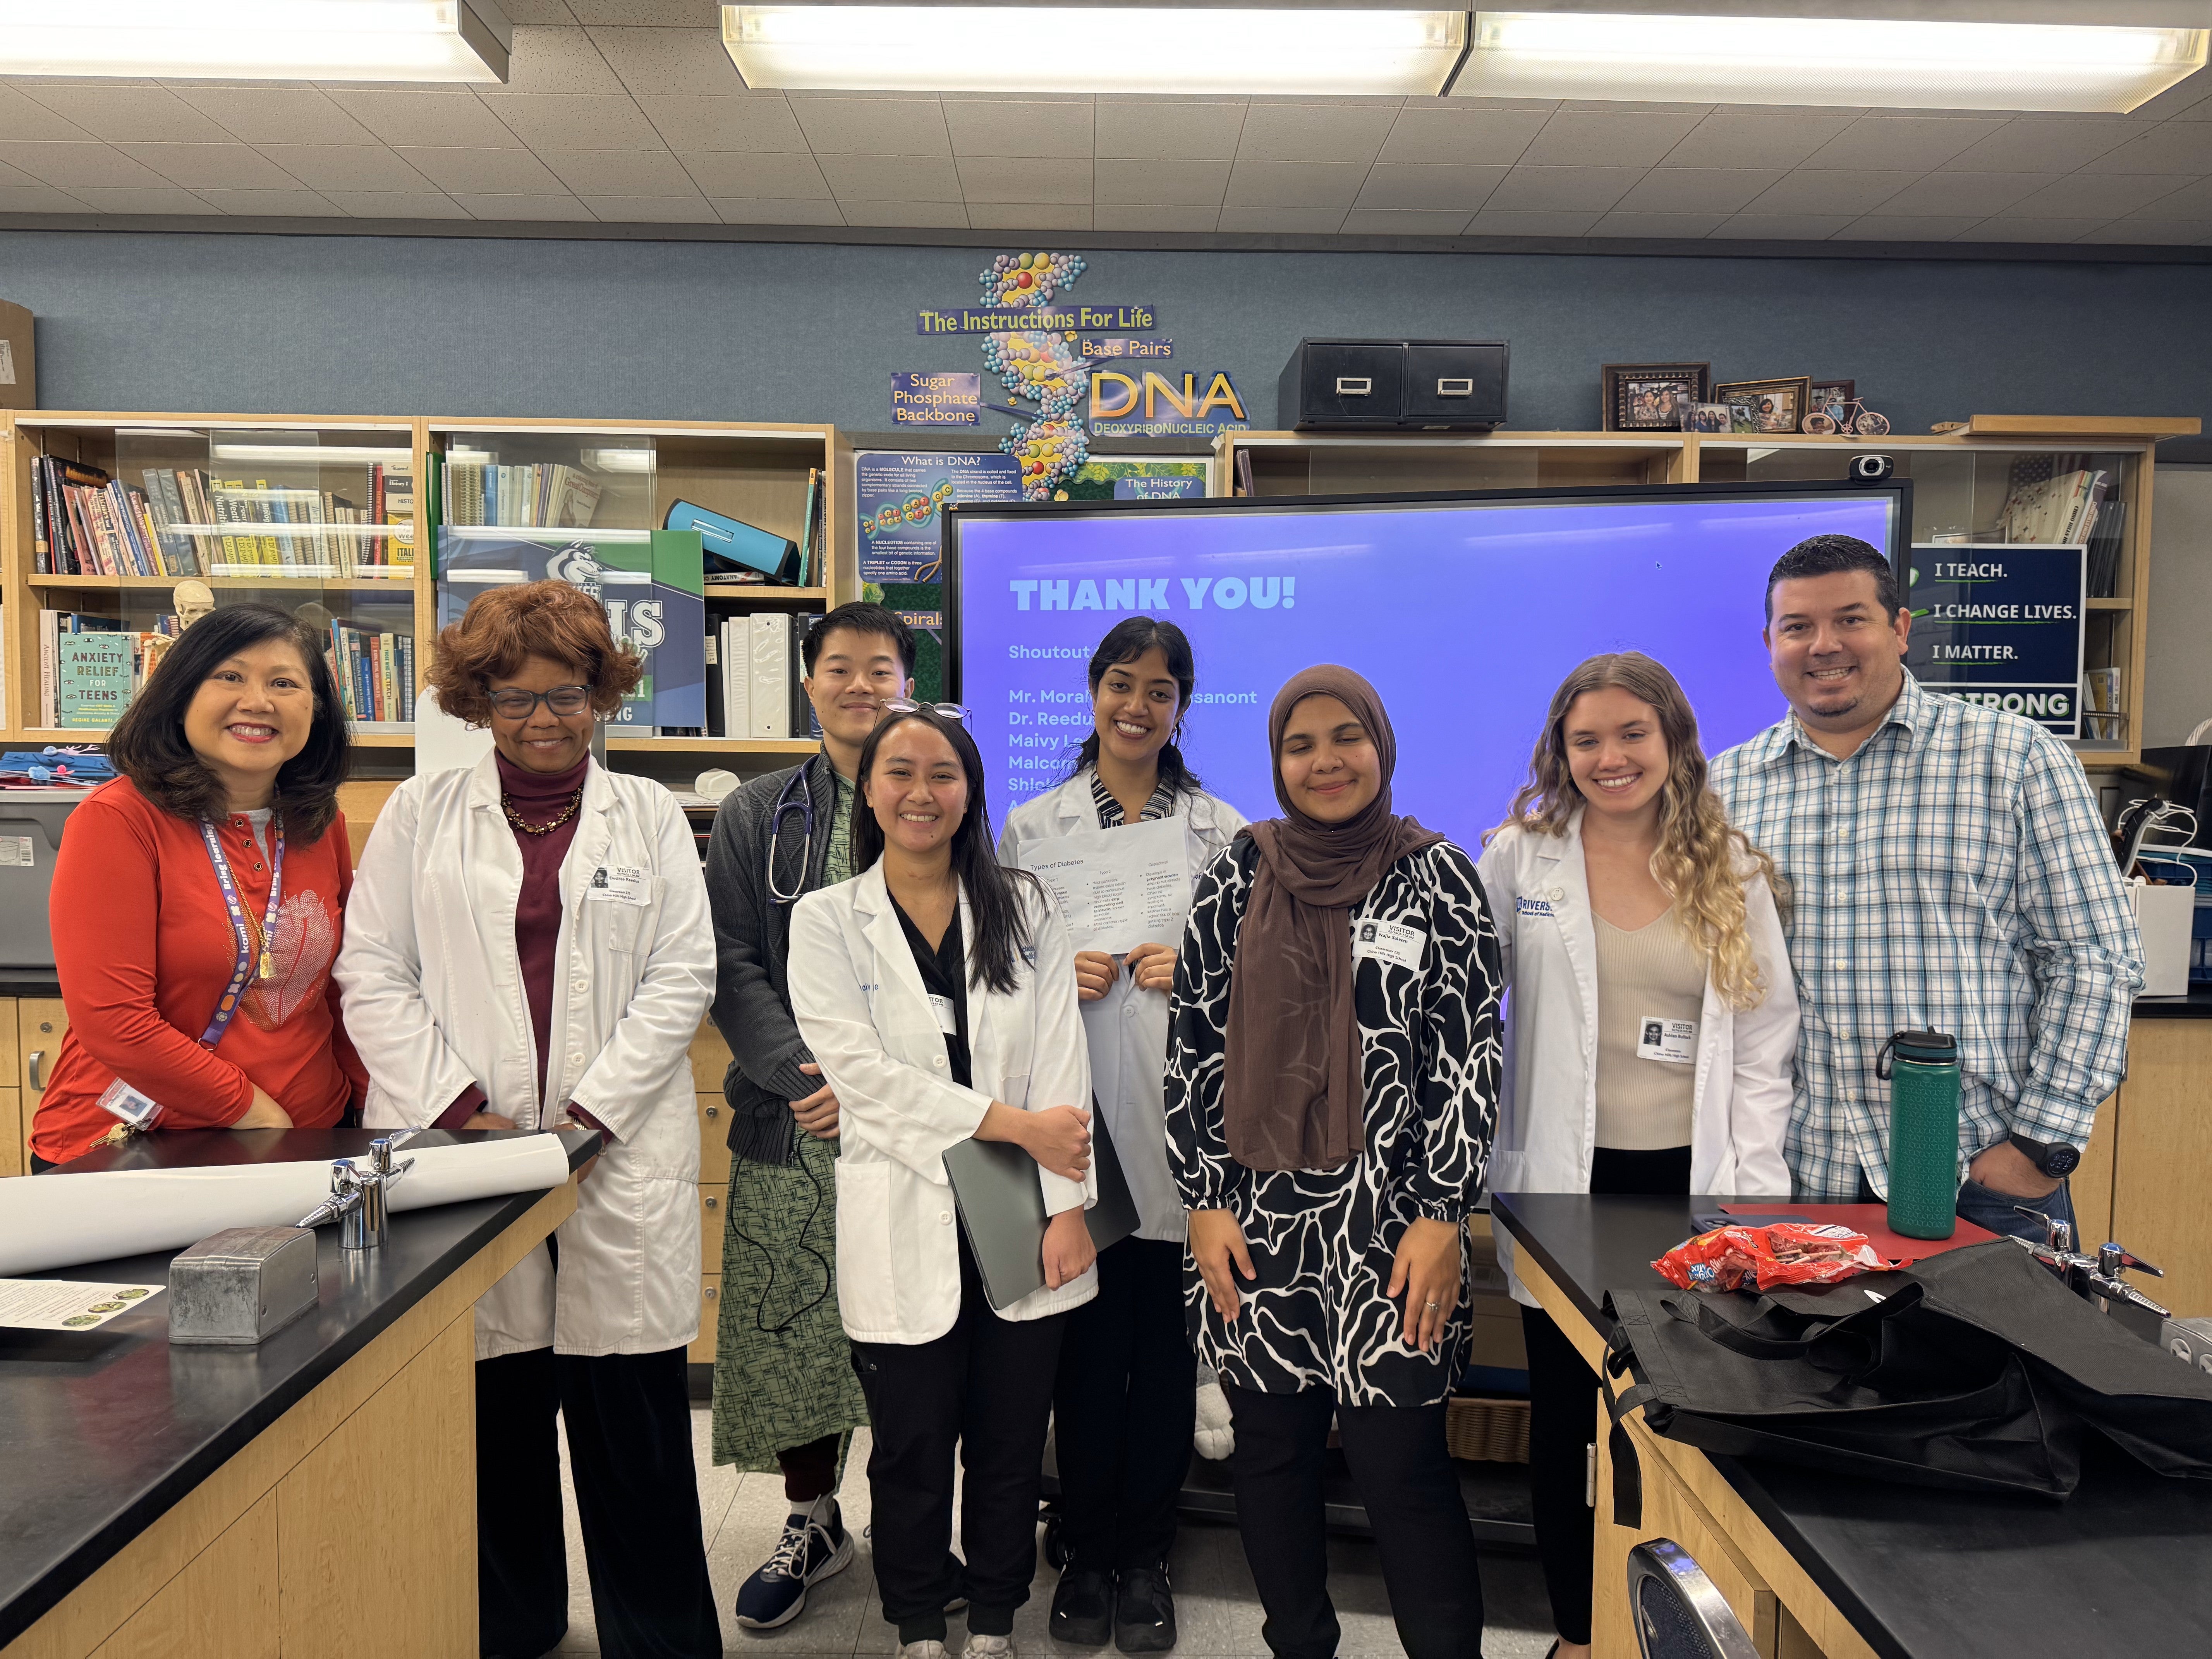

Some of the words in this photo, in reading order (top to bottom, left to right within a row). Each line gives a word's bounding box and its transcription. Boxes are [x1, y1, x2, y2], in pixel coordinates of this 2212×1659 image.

[920, 311, 957, 331] The
[963, 310, 1074, 330] Instructions
[1080, 307, 1113, 328] For
[1119, 306, 1152, 328] Life
[1082, 342, 1122, 356] Base
[1128, 342, 1171, 357] Pairs
[910, 374, 955, 390] Sugar
[893, 391, 977, 407] Phosphate
[1091, 373, 1246, 417] DNA
[896, 408, 975, 422] Backbone
[902, 456, 933, 465] What
[936, 457, 943, 465] is
[948, 457, 980, 465] DNA?
[565, 477, 579, 489] Great
[1126, 479, 1147, 488] The
[1151, 479, 1192, 489] History
[397, 548, 414, 556] ITALI
[1935, 563, 1941, 576] I
[1946, 563, 2007, 577] TEACH.
[1010, 578, 1170, 611] THANK
[1181, 577, 1295, 609] YOU!
[895, 611, 942, 625] piral
[1934, 605, 1940, 618] I
[1946, 604, 2018, 618] CHANGE
[2025, 605, 2077, 619] LIVES.
[72, 653, 123, 663] ANXIETY
[1009, 645, 1090, 659] Shoutout
[1932, 646, 1939, 658] I
[1945, 645, 2018, 659] MATTER.
[77, 666, 118, 676] RELIEF
[79, 690, 117, 700] TEENS
[1009, 690, 1036, 703] Mr.
[1041, 689, 1091, 703] Moral
[1192, 690, 1257, 704] sanont
[1009, 712, 1032, 725] Dr.
[1038, 712, 1092, 725] Reedu
[1009, 733, 1059, 750] Maivy
[206, 823, 222, 862] learning
[1058, 859, 1084, 867] Diabetes
[219, 864, 231, 890] Bring
[1523, 900, 1552, 911] RIVERS
[1389, 925, 1414, 936] VISITOR
[236, 924, 249, 953] kami
